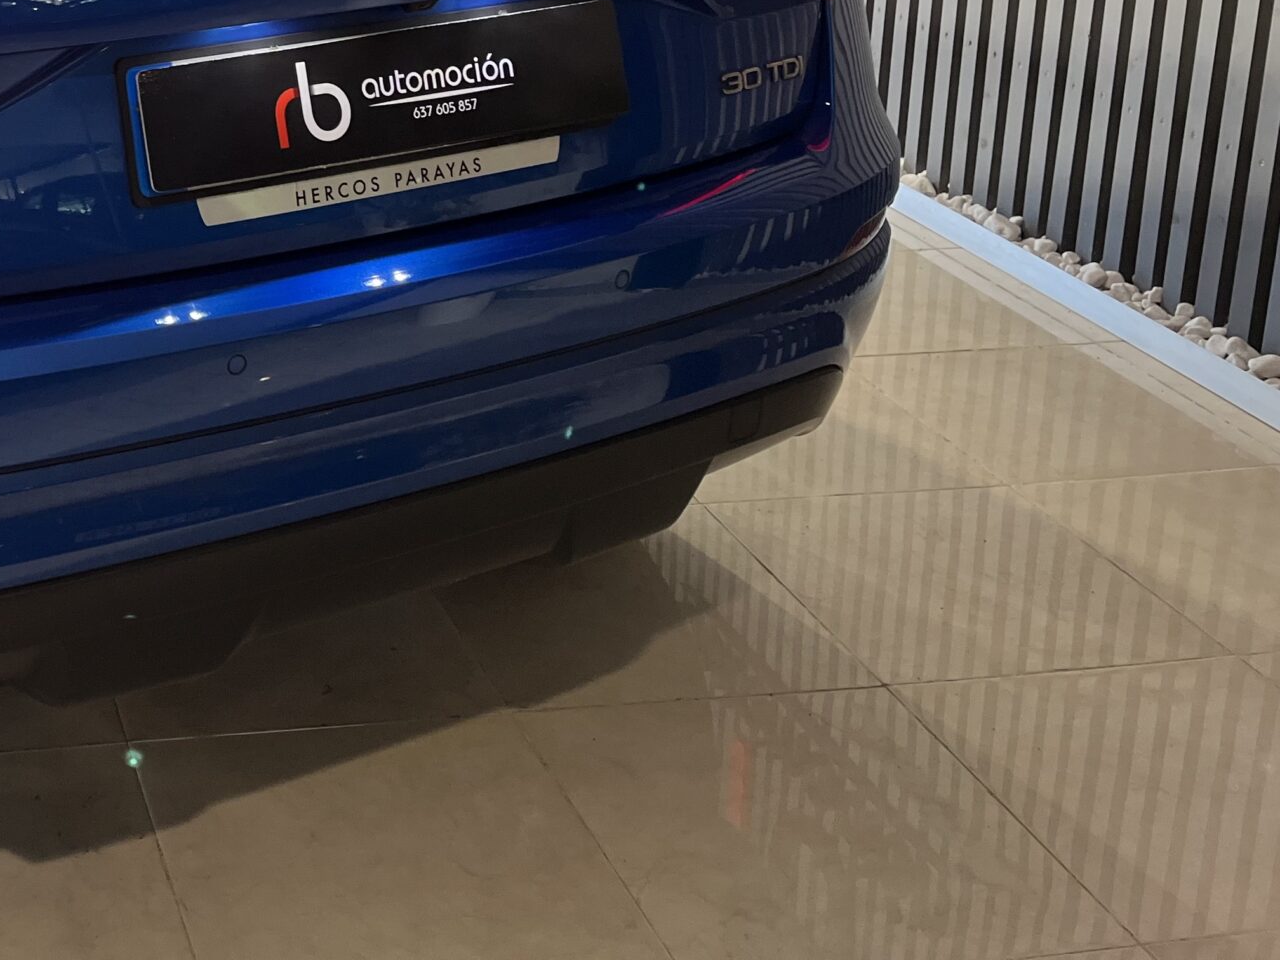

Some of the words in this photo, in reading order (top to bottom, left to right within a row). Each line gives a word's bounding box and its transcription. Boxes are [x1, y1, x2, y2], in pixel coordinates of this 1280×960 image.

[361, 52, 515, 100] automoción
[274, 60, 352, 149] rb
[412, 105, 433, 120] 637
[435, 101, 456, 116] 605
[458, 97, 478, 112] 857
[295, 176, 381, 207] HERCOS
[394, 157, 482, 189] PARAYAS
